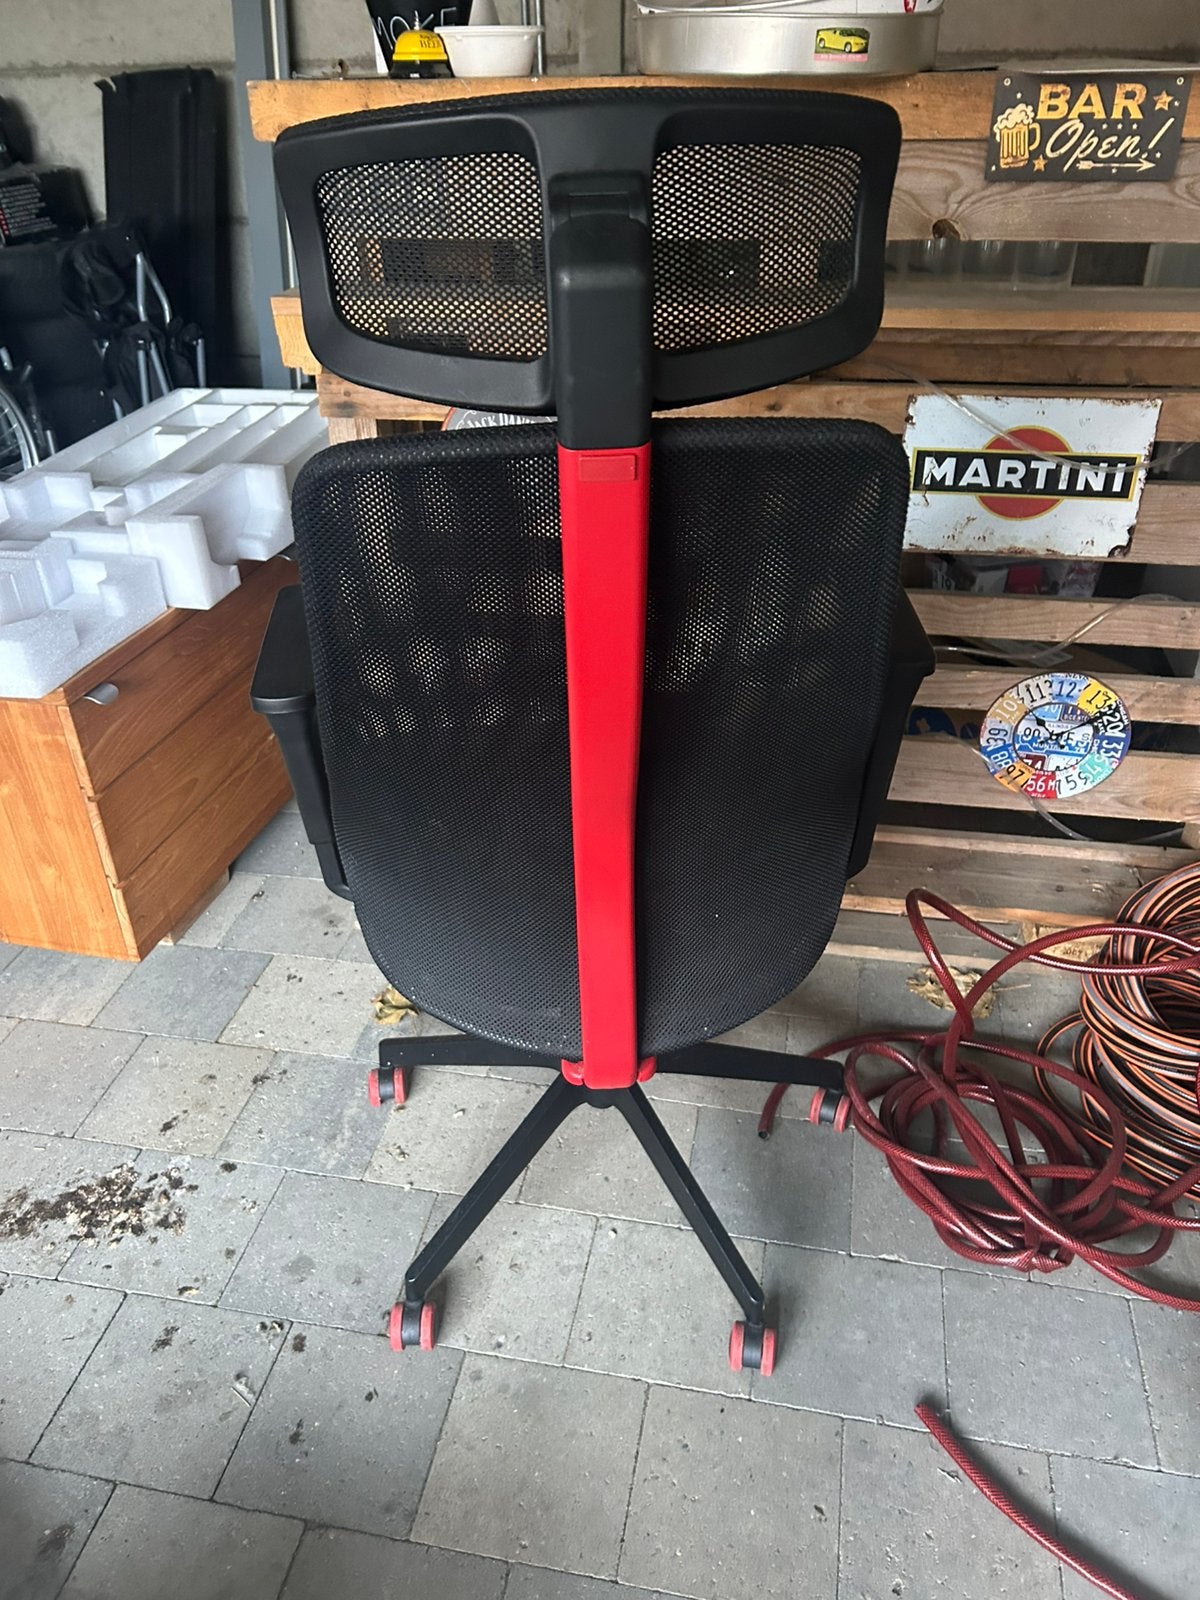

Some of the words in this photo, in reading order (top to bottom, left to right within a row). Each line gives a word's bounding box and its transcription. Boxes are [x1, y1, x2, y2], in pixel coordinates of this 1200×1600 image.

[1036, 83, 1148, 120] BAR
[1045, 117, 1175, 173] Open!
[922, 456, 1127, 493] MARTINI
[1055, 680, 1077, 698] 12
[1086, 689, 1112, 710] 13
[996, 701, 1018, 719] 10
[1101, 739, 1124, 759] 33
[1026, 775, 1046, 792] 56
